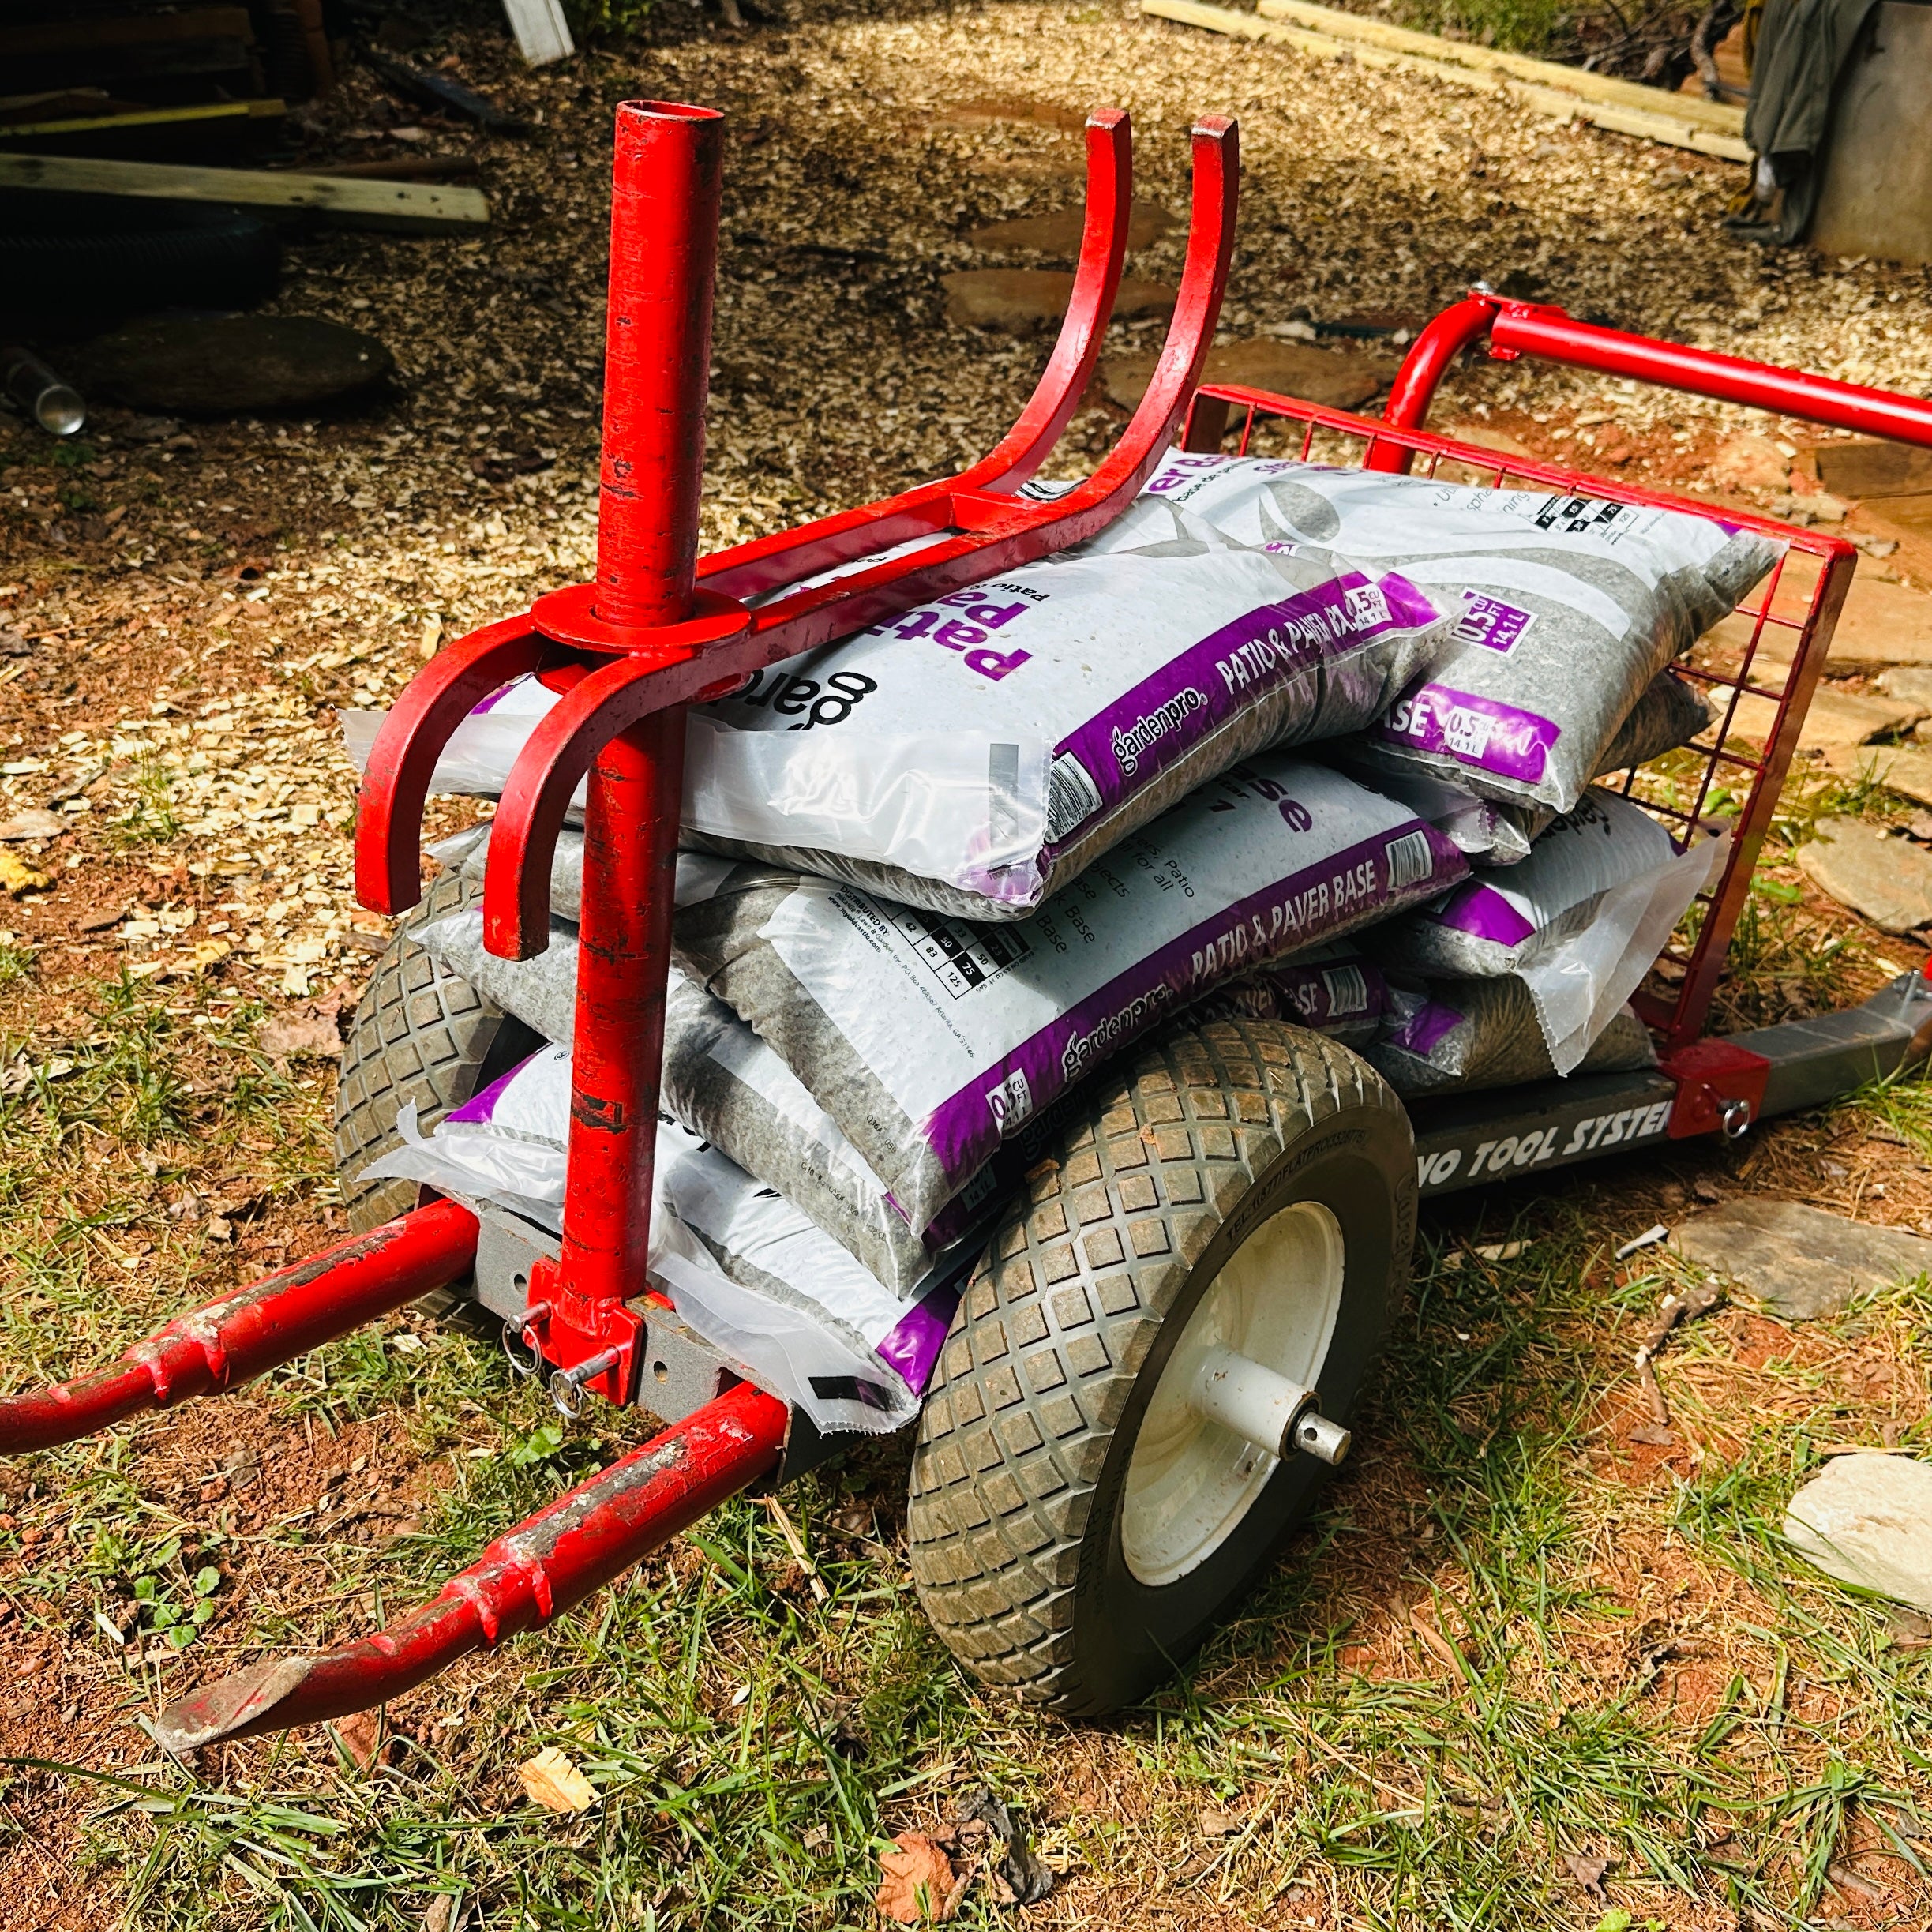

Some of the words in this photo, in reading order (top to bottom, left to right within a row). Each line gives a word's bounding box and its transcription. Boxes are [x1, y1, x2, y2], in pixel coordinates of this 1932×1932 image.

[936, 591, 1031, 630] Pa
[1368, 590, 1380, 600] CU
[1373, 600, 1383, 609] FT
[1489, 602, 1504, 618] FT
[865, 610, 1034, 682] Pati
[1492, 619, 1520, 645] 14.1
[1215, 639, 1276, 696] PATIO
[1268, 628, 1293, 661] &
[1384, 699, 1431, 737] SE
[1449, 712, 1481, 737] 0.5
[1449, 737, 1471, 752] 14.1
[1226, 763, 1313, 832] ase
[1071, 877, 1097, 900] ase
[1131, 852, 1156, 872] for
[1153, 875, 1174, 892] all
[1164, 859, 1195, 898] Patio
[840, 885, 881, 925] DISTRIBUTED
[878, 922, 891, 937] BY:
[1064, 905, 1096, 943] Base
[1191, 924, 1249, 985] PATIO
[1251, 914, 1268, 947] &
[1270, 882, 1330, 940] PAVER
[1332, 859, 1377, 908] BASE
[905, 921, 917, 933] 42
[925, 945, 938, 958] 83
[947, 971, 962, 988] 125
[940, 936, 954, 949] 50
[962, 962, 976, 976] 75
[955, 926, 967, 938] 33
[977, 953, 989, 966] 50
[1012, 1079, 1025, 1092] CU
[1016, 1090, 1027, 1103] FT
[1467, 1126, 1559, 1178] TOOL
